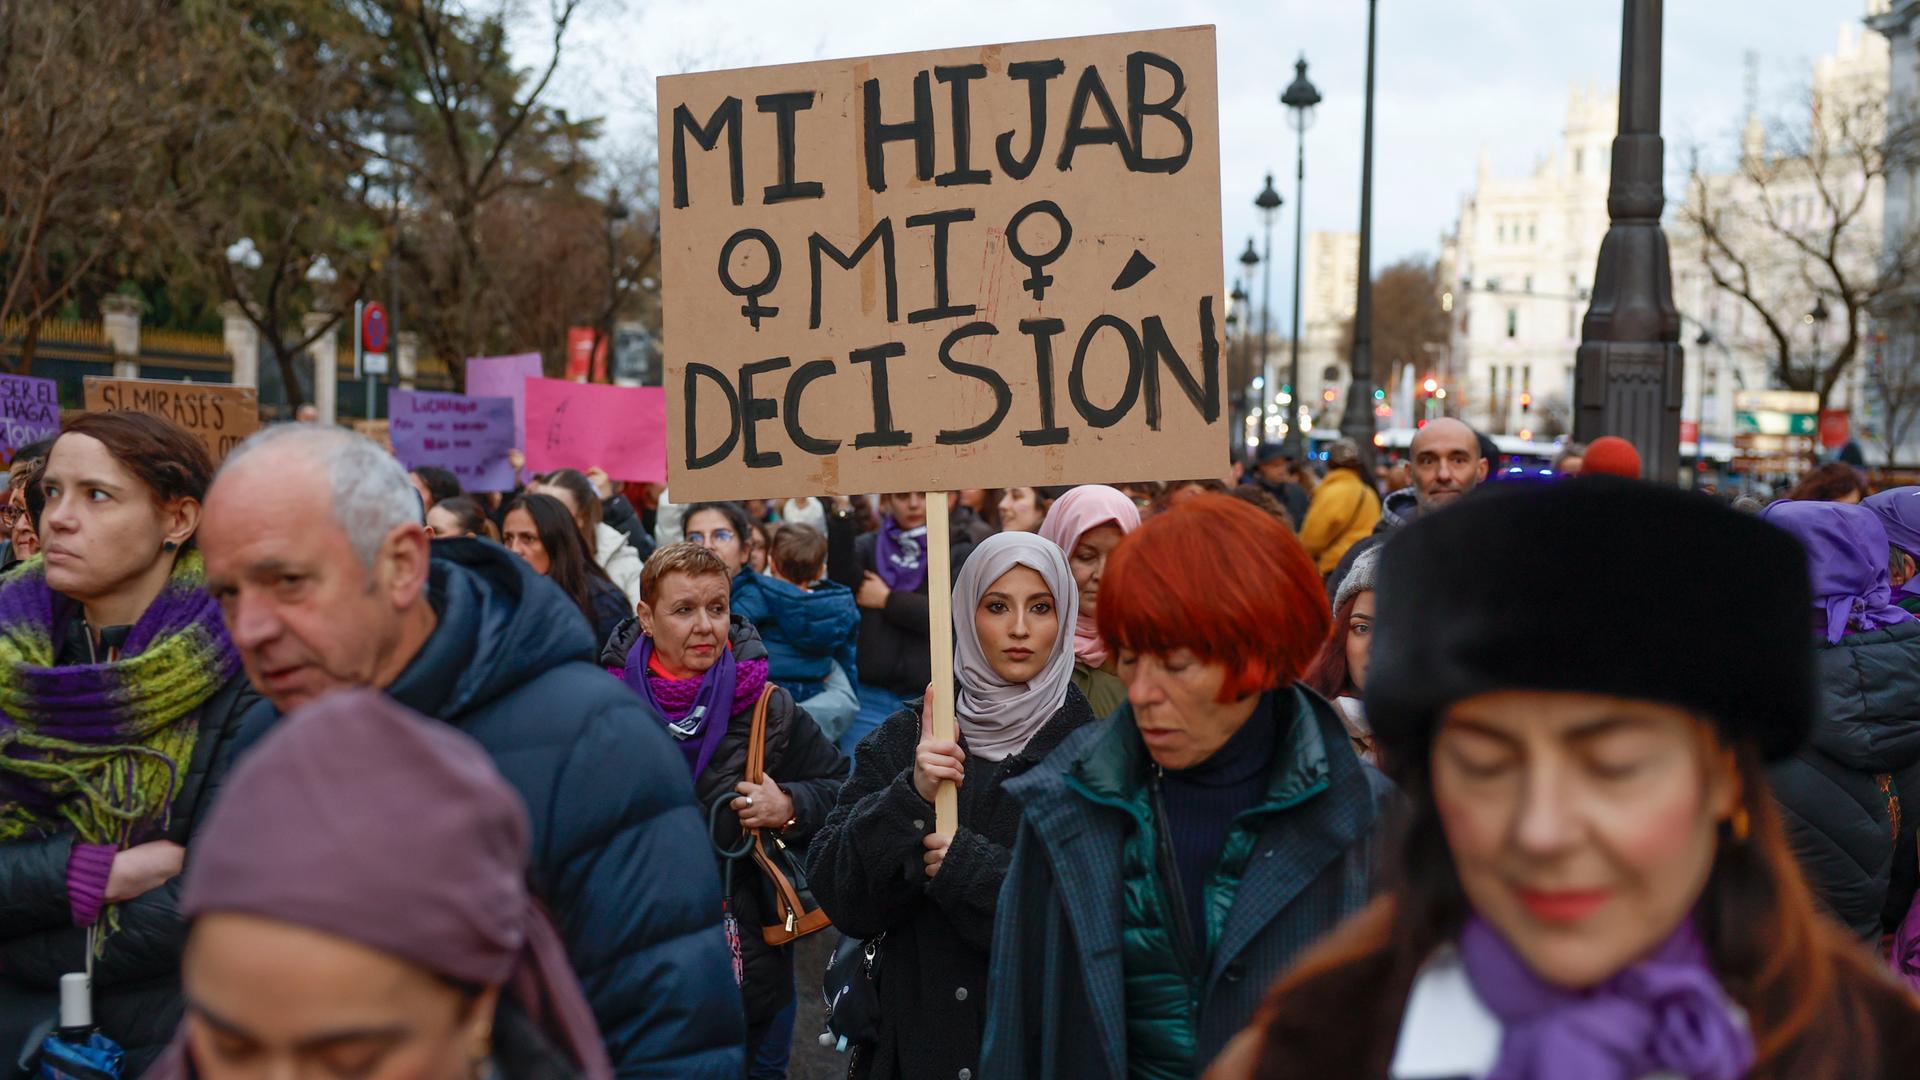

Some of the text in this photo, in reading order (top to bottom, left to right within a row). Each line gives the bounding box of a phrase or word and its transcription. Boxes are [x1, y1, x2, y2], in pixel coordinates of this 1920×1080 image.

[673, 51, 1193, 209] MI HIJAB
[808, 207, 977, 331] MI
[3, 399, 53, 423] HAGA
[684, 250, 1221, 470] DECISIÓN
